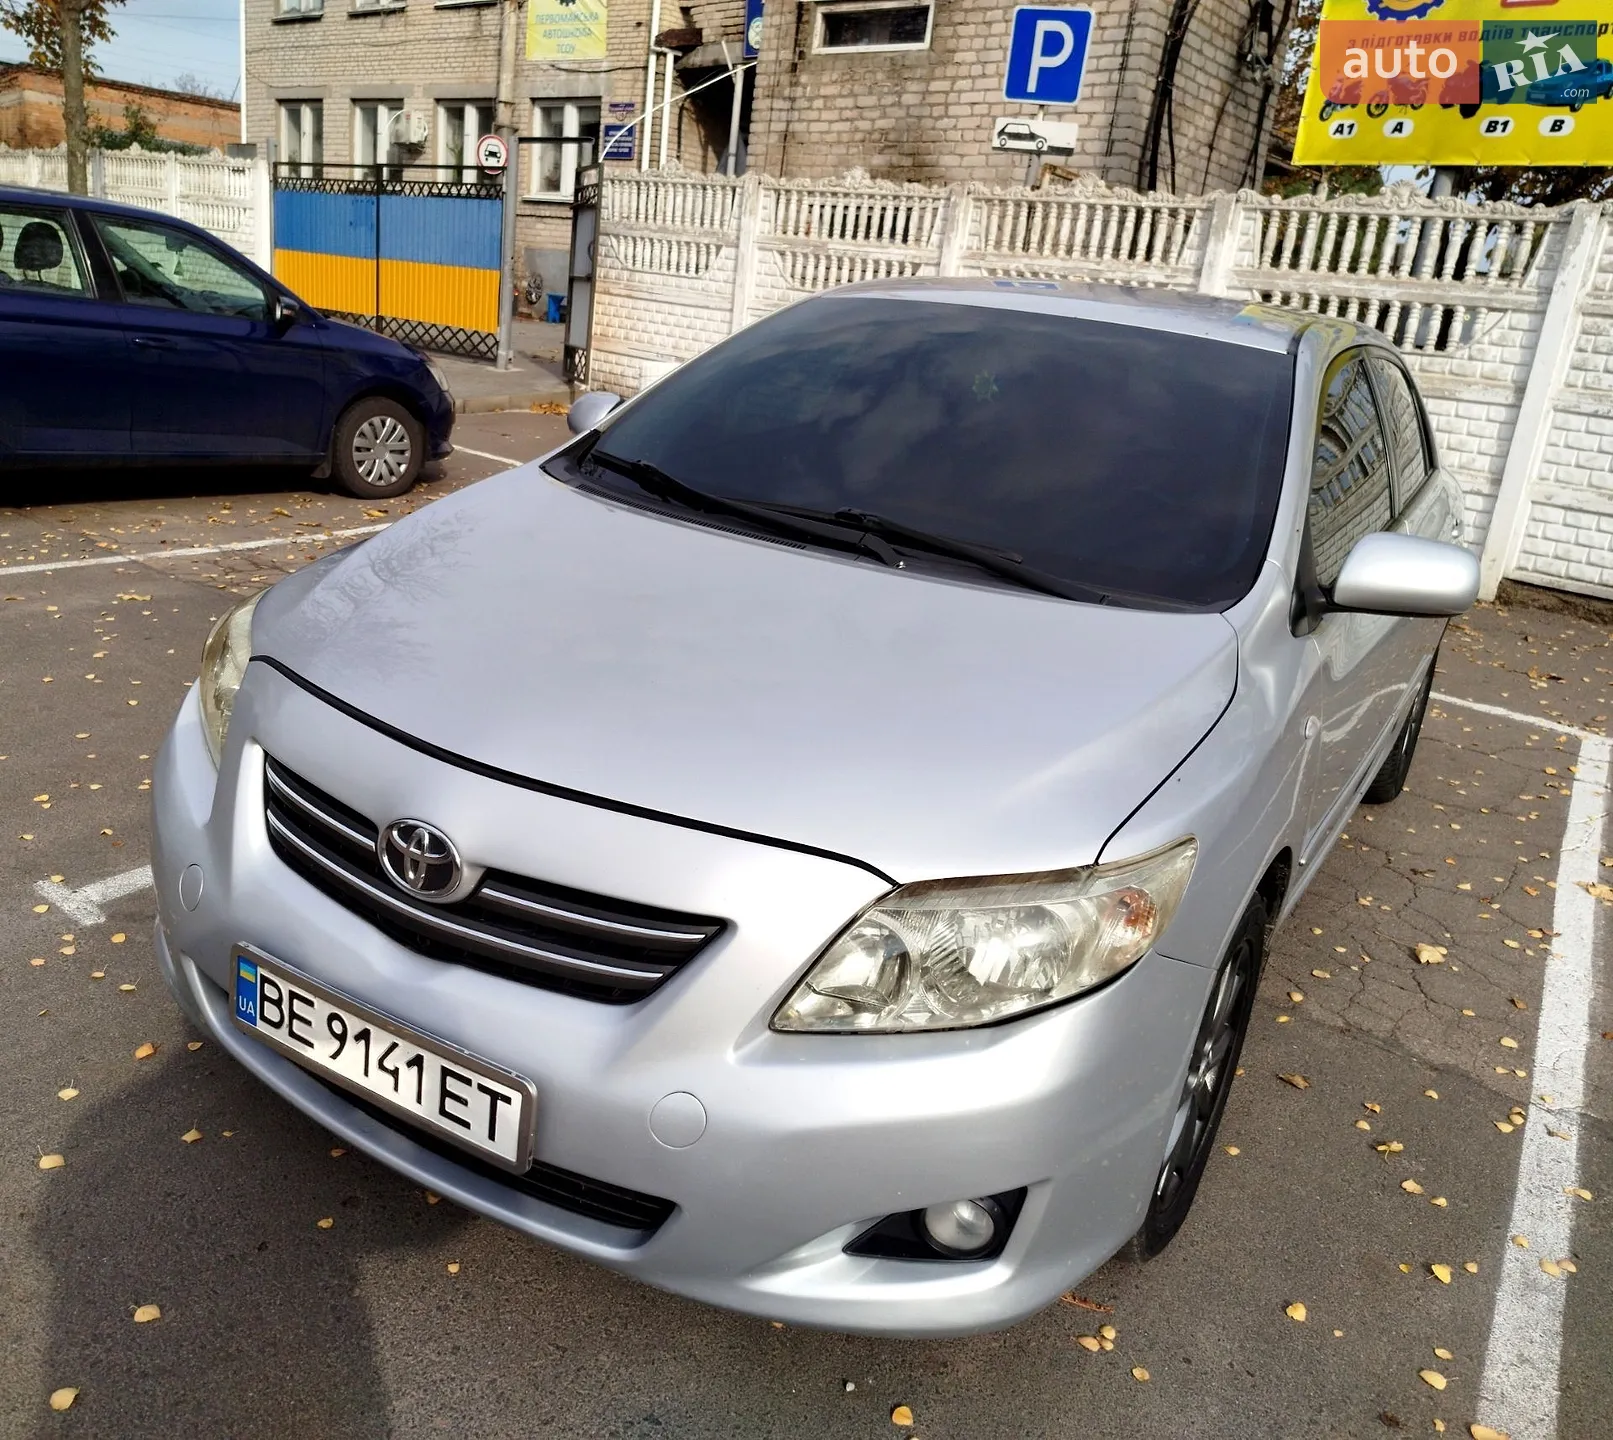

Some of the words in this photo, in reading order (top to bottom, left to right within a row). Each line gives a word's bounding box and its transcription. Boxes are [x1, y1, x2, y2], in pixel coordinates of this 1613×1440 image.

[1521, 22, 1613, 38] транспор
[1026, 19, 1075, 93] P
[1333, 122, 1356, 136] A1
[1390, 121, 1404, 134] A
[1484, 120, 1510, 133] B1
[1549, 119, 1565, 133] B
[238, 994, 255, 1018] UA
[258, 971, 315, 1050] BE
[326, 1011, 425, 1106] 9141
[438, 1064, 513, 1143] ET
